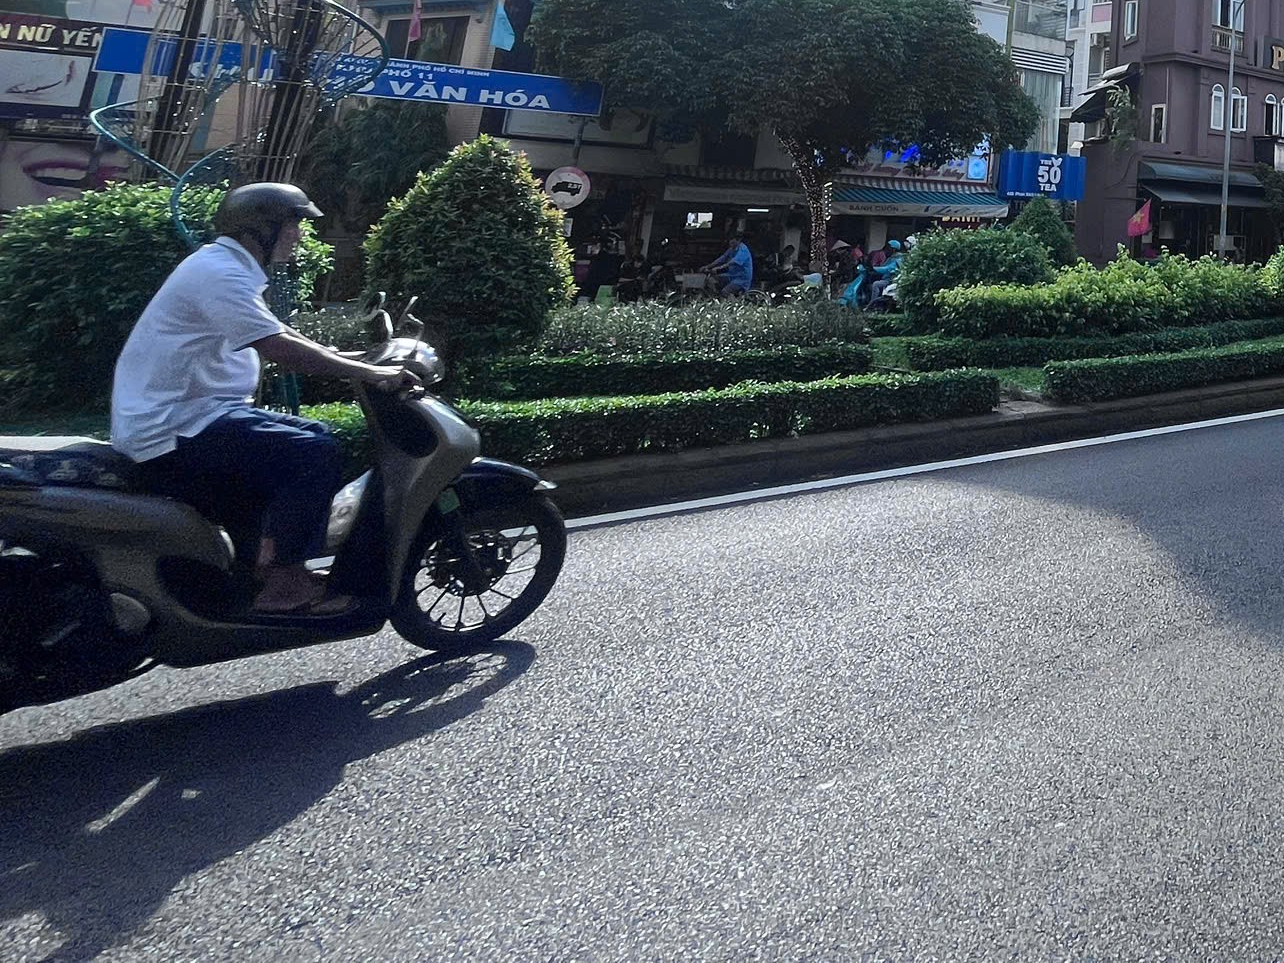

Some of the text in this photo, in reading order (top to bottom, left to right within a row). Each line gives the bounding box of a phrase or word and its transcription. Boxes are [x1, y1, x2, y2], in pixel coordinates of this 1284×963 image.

[17, 23, 56, 43] NỮ
[417, 72, 433, 80] 11
[389, 80, 467, 101] VĂN
[478, 89, 551, 109] HÓA
[1038, 165, 1061, 184] 50
[1039, 183, 1057, 192] TEA
